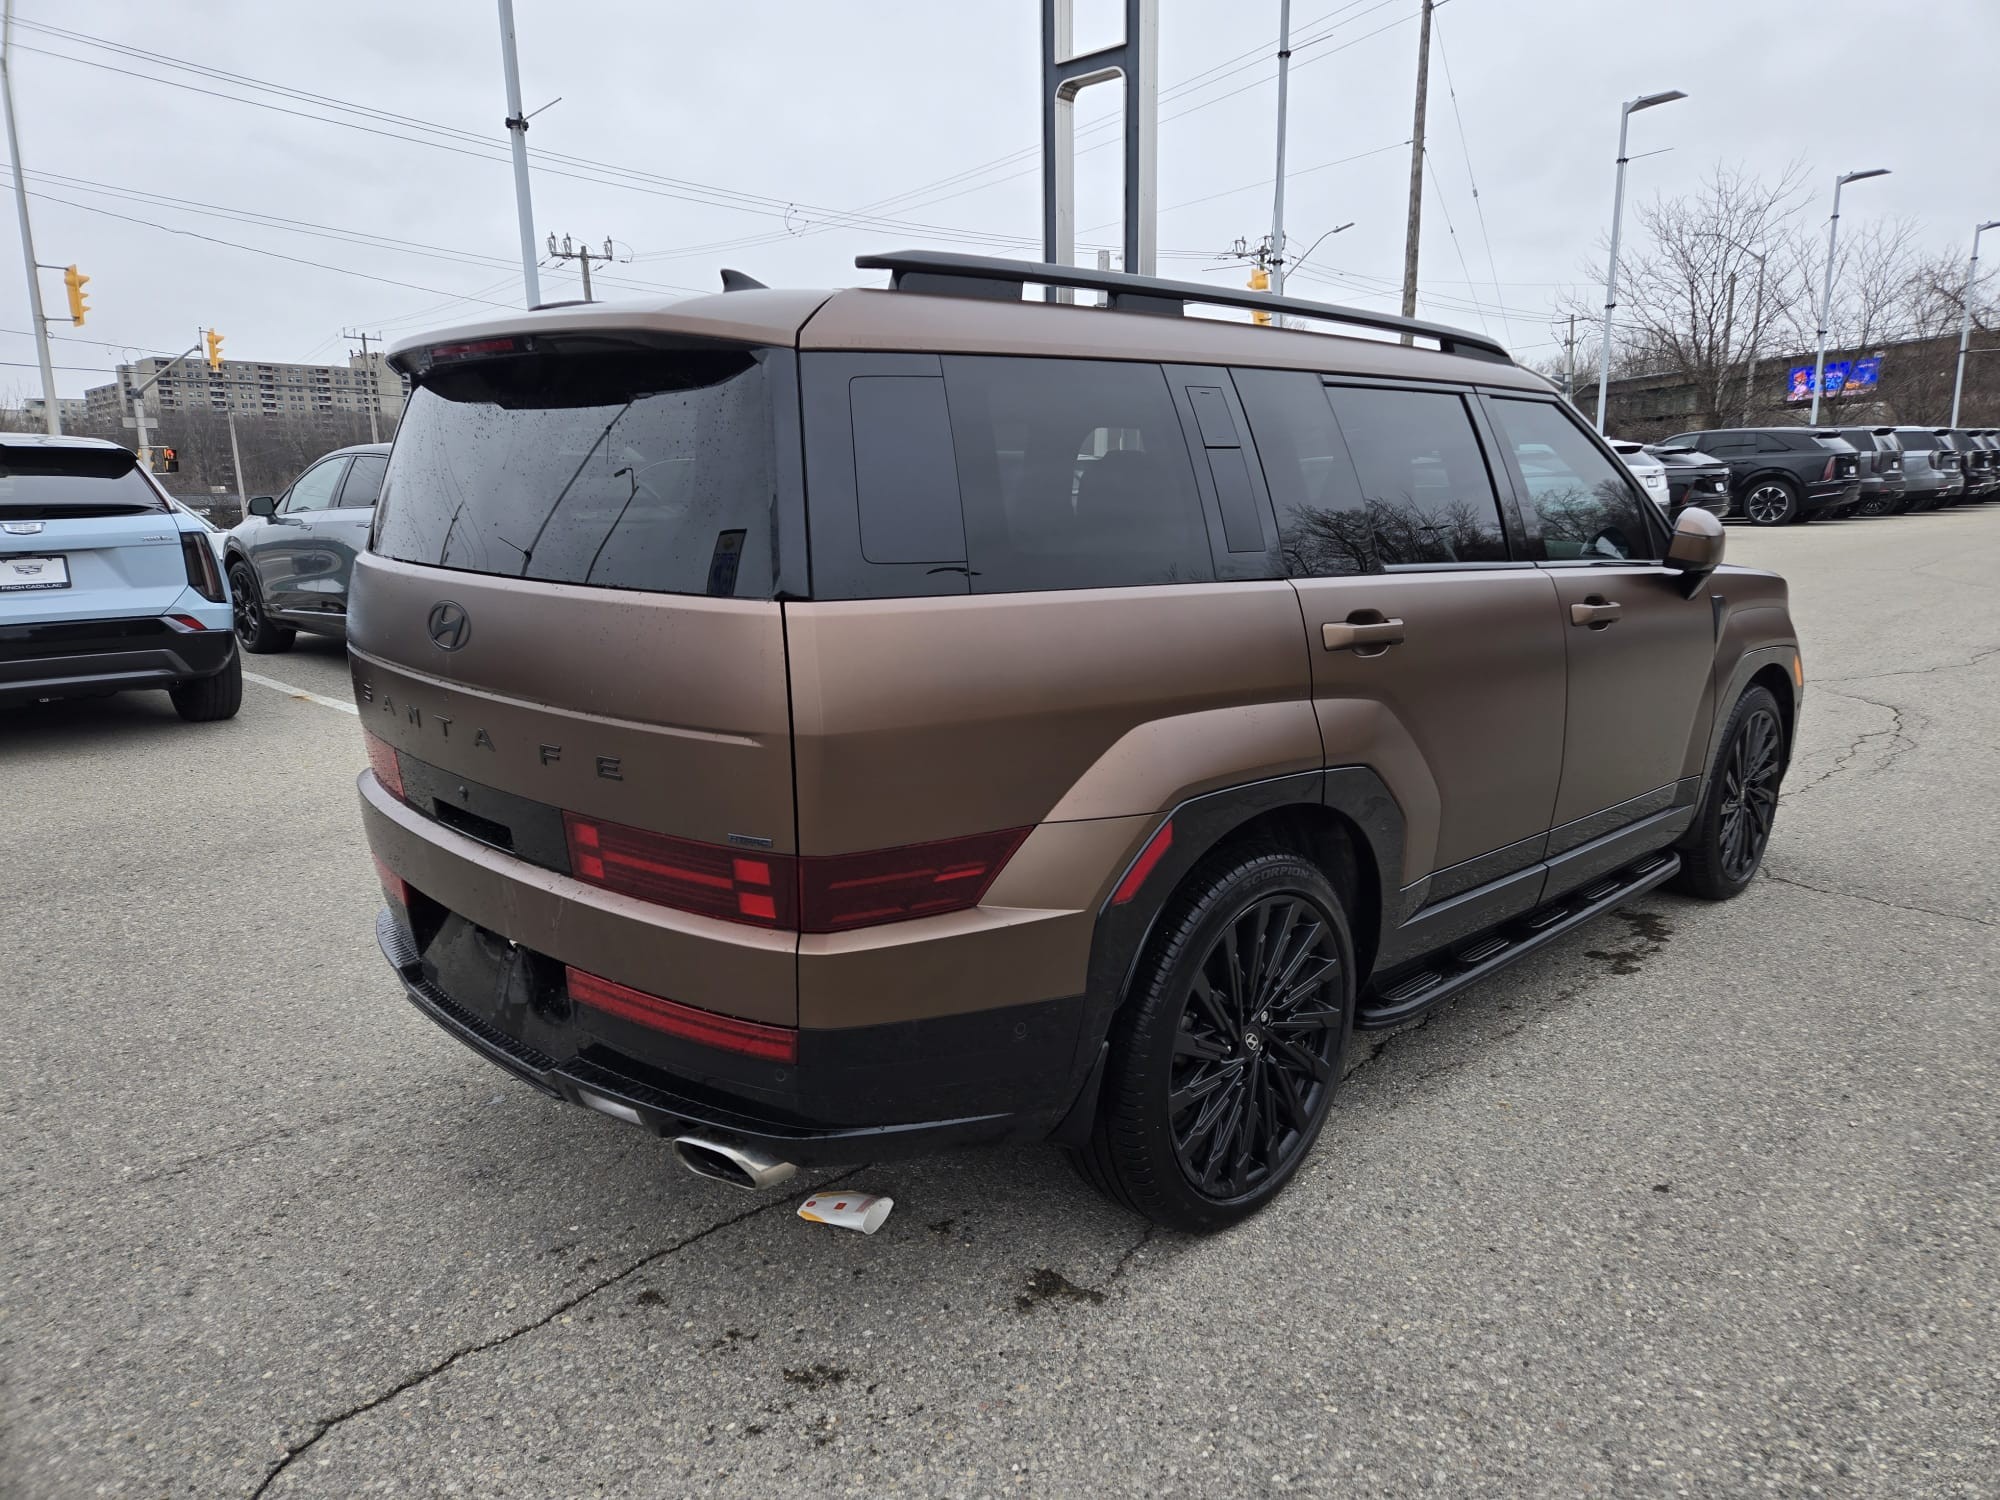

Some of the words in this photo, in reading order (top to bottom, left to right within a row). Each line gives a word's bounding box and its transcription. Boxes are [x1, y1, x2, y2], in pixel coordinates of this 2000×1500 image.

[362, 683, 496, 752] SANTA
[539, 743, 623, 781] FE
[1243, 866, 1310, 888] SCORPION
